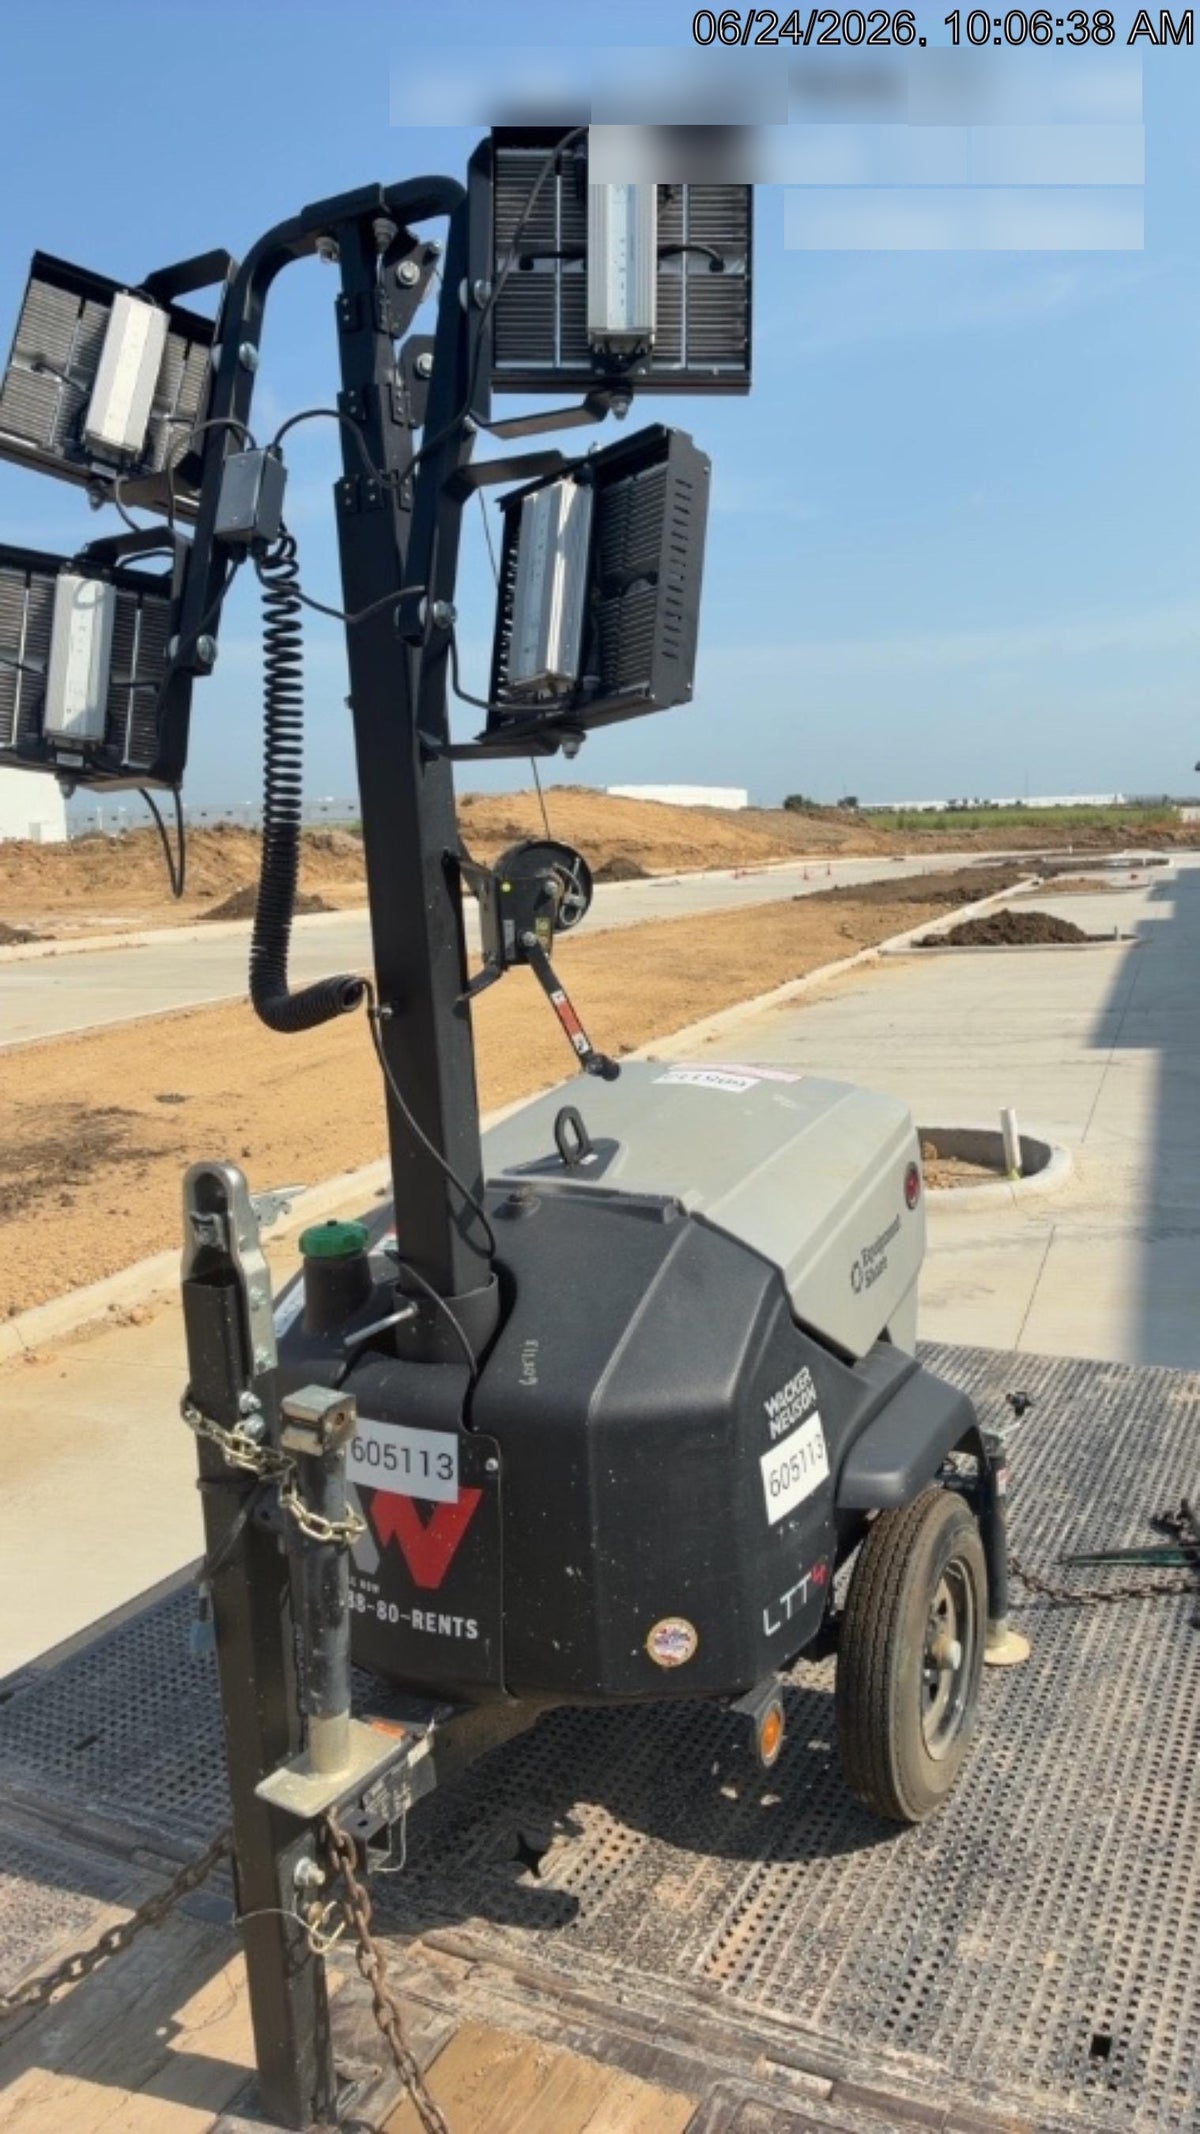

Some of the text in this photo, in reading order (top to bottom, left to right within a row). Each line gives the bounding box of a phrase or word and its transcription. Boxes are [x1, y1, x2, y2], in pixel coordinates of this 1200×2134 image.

[764, 1365, 812, 1418] WACKER
[769, 1384, 817, 1440] NEUSON
[351, 1436, 454, 1481] 605113
[769, 1434, 823, 1497] 605113
